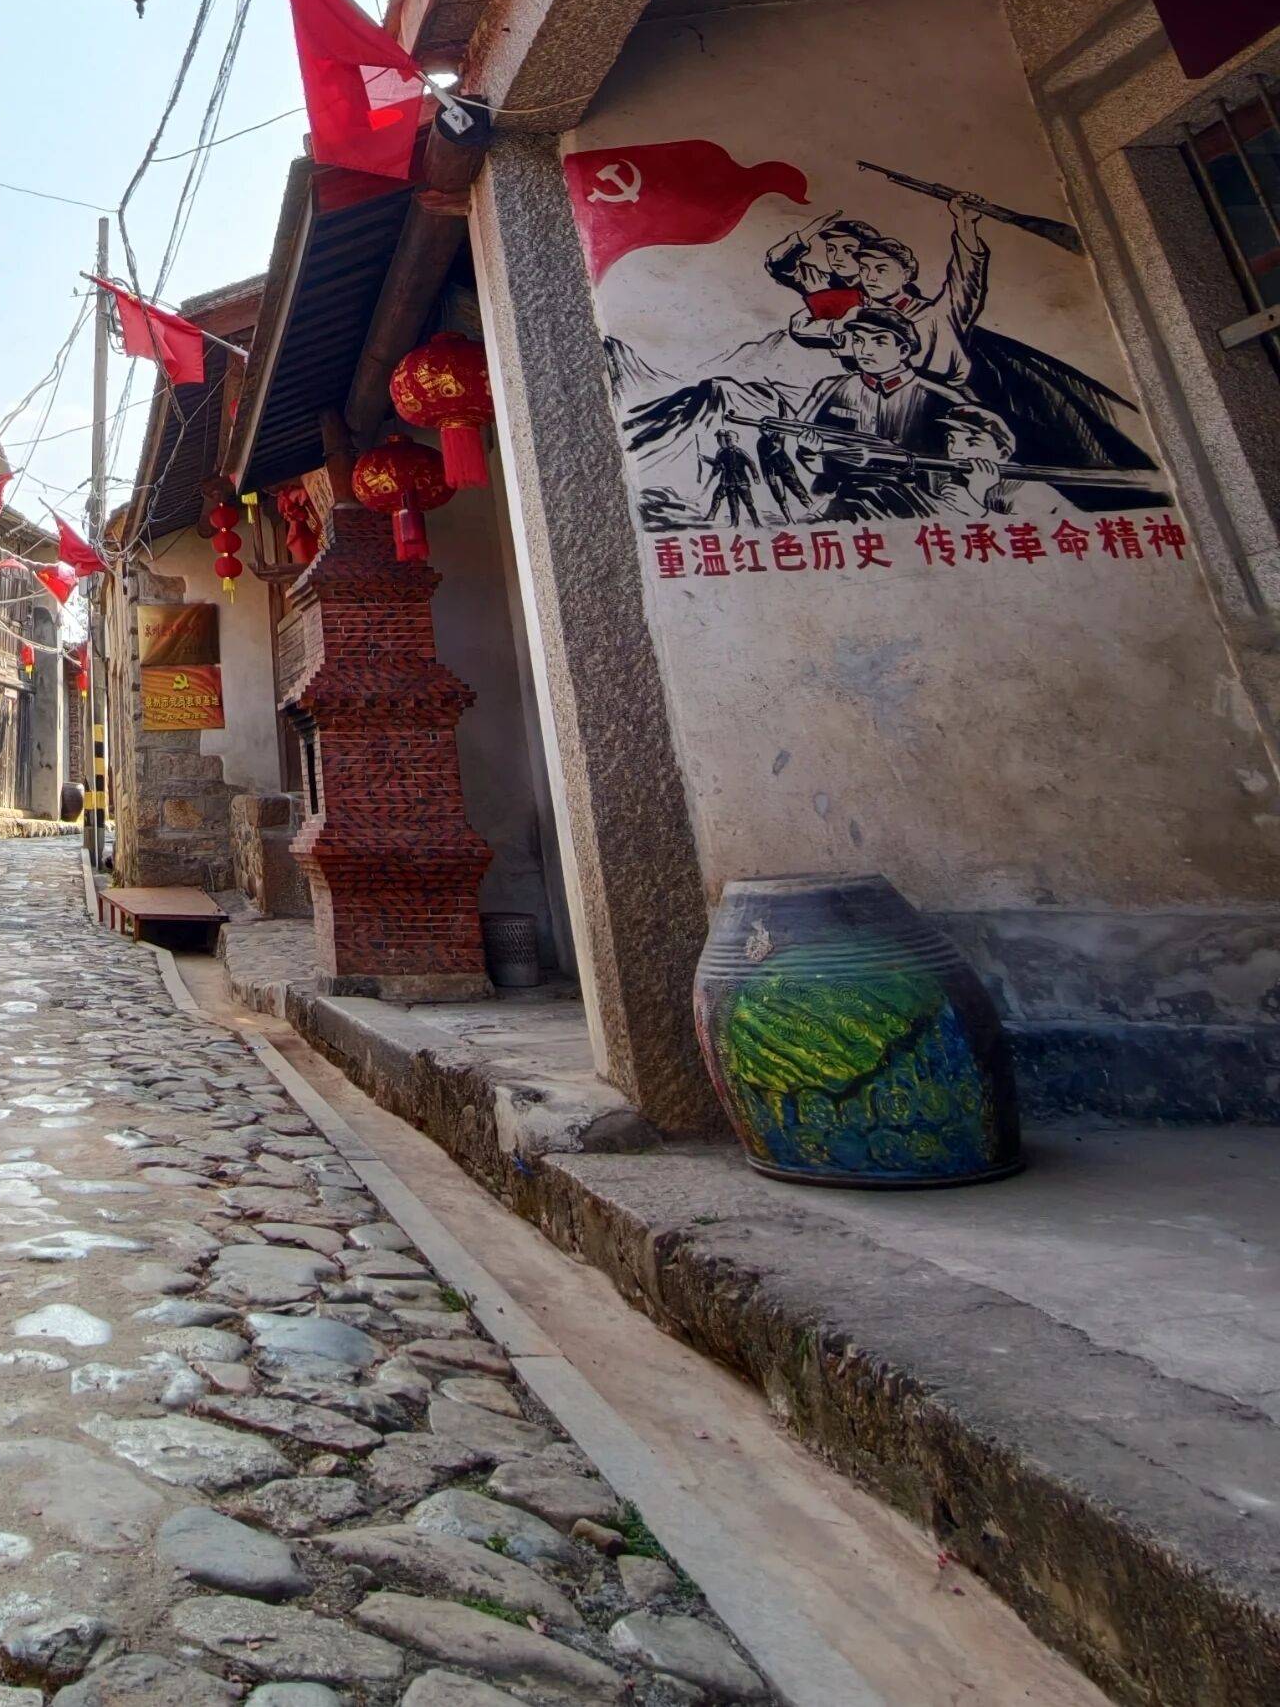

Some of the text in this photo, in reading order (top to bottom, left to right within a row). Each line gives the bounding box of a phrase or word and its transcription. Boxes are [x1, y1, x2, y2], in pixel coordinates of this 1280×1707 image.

[654, 514, 1187, 579] 重温红色历史 传承革命精神
